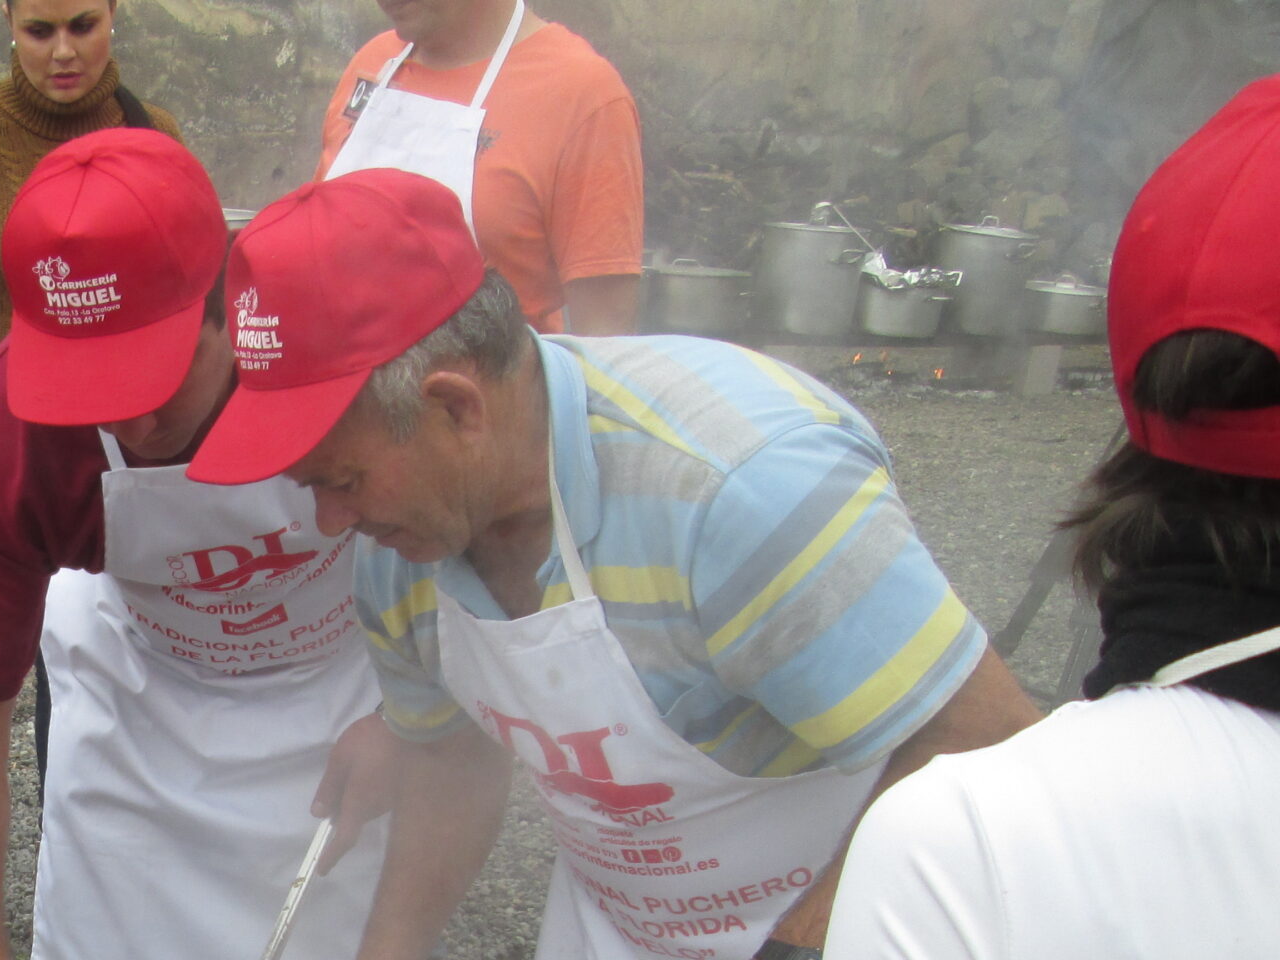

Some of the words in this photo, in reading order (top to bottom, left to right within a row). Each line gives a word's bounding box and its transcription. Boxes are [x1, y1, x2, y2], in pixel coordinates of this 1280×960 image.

[46, 286, 122, 308] MIGUEL
[237, 329, 283, 349] MIGUEL
[227, 613, 282, 635] facebook
[171, 646, 203, 660] DE
[210, 655, 241, 664] LA
[249, 619, 356, 663] FLORIDA
[642, 866, 814, 915] PUCHERO
